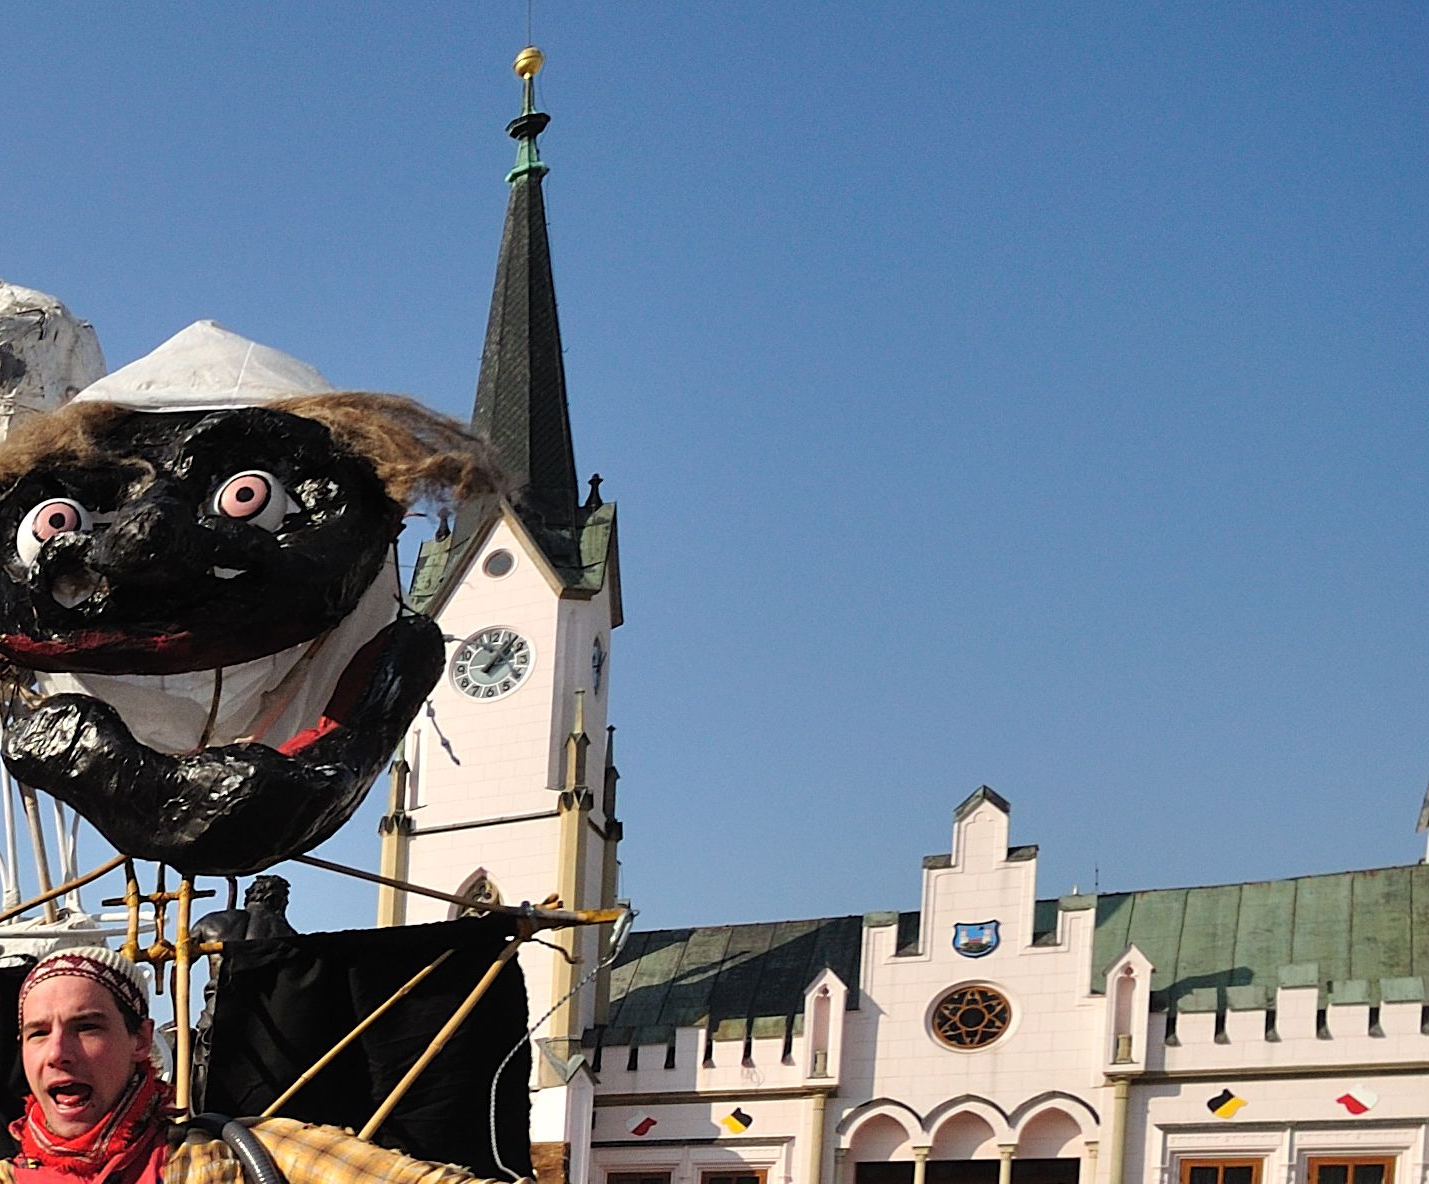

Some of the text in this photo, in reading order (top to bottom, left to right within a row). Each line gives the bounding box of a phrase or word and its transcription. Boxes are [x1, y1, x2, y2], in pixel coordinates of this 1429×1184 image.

[515, 641, 524, 652] 2
[460, 650, 472, 662] 10
[457, 665, 465, 674] 9
[472, 685, 480, 697] 7
[502, 681, 511, 691] 5
[486, 687, 495, 697] 6
